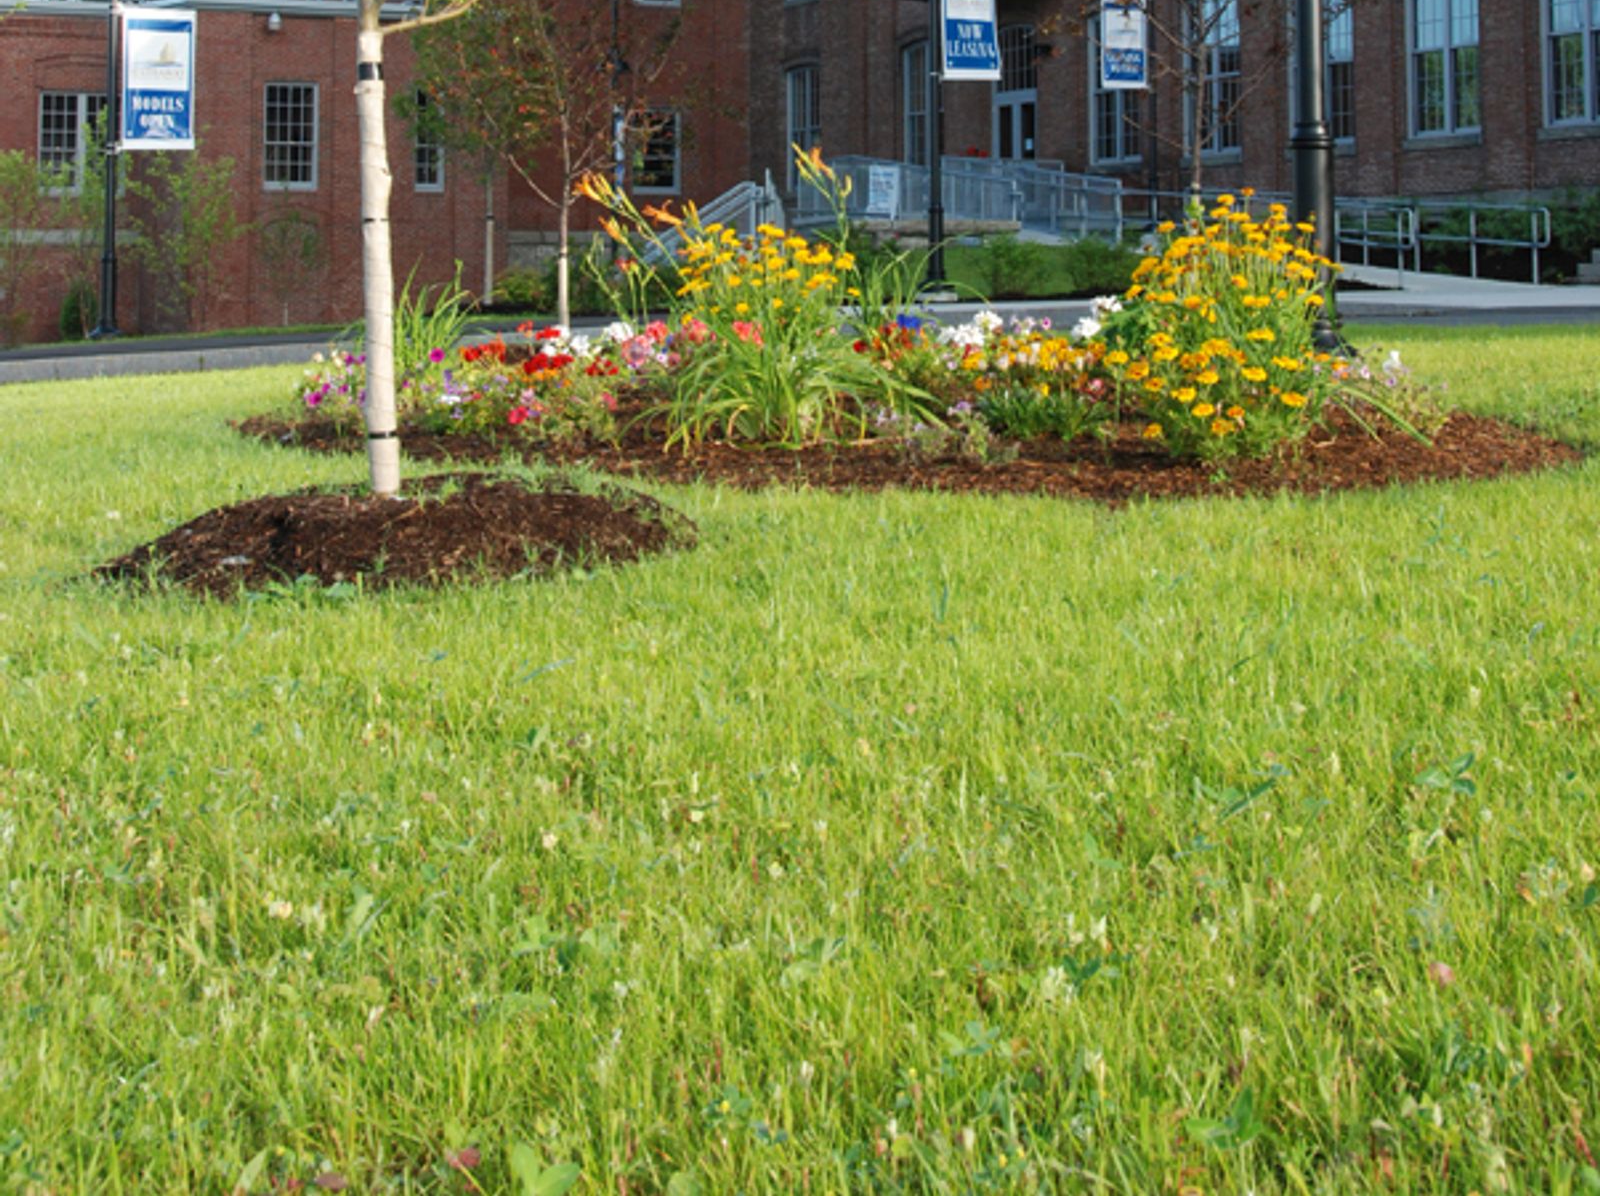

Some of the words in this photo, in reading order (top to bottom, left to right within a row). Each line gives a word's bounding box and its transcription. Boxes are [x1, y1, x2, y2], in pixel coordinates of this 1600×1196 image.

[957, 24, 983, 39] NOW
[947, 40, 995, 58] LEASING
[132, 96, 184, 111] MODELS
